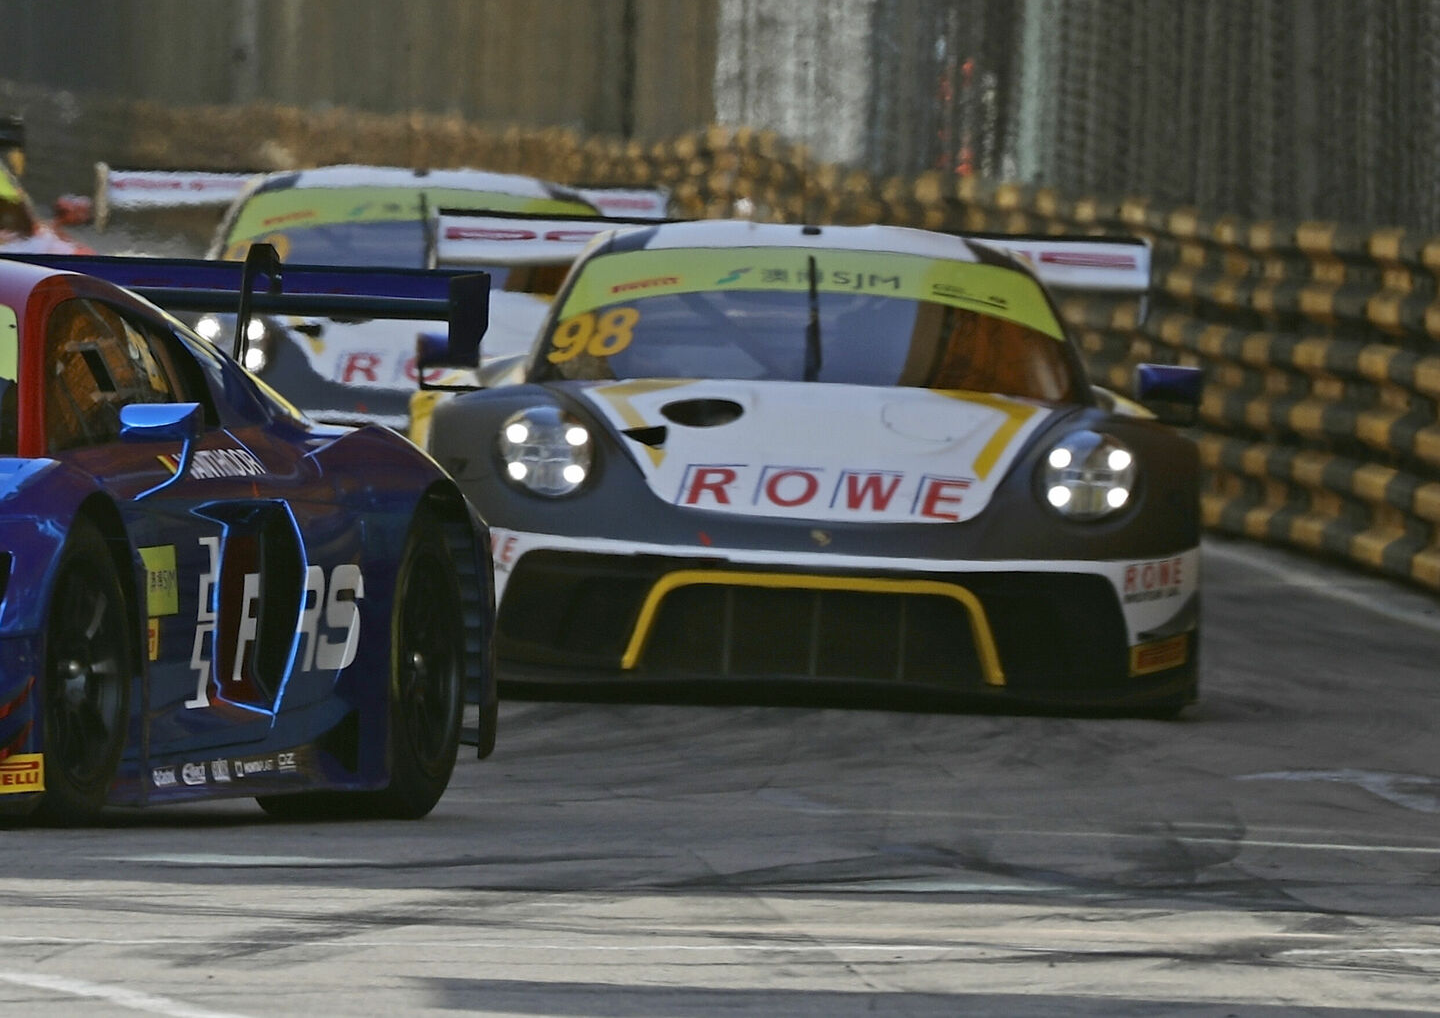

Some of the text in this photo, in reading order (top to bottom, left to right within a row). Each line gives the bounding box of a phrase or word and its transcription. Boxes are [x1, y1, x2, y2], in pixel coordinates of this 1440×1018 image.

[832, 270, 901, 290] SJM
[547, 307, 640, 364] 98
[685, 467, 971, 522] ROWE
